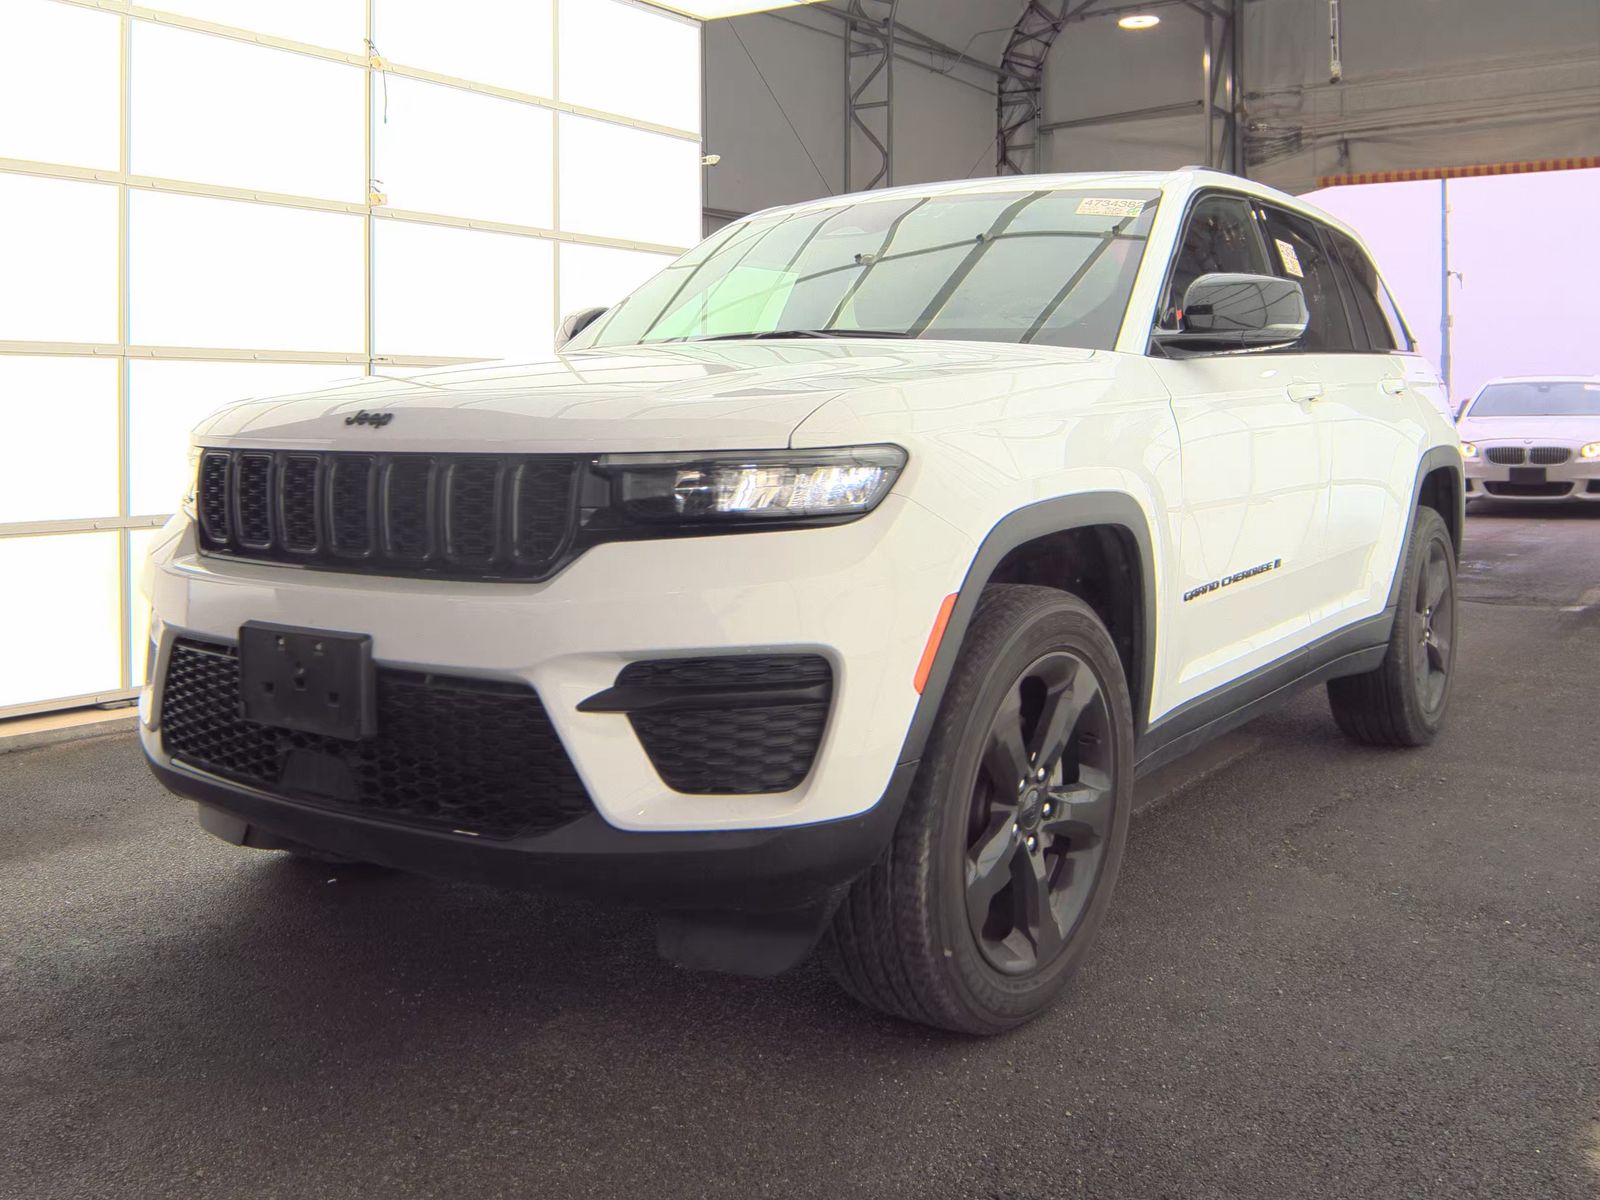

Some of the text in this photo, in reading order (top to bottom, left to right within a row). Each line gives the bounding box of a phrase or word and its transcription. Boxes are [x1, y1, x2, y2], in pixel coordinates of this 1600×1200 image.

[344, 409, 393, 429] Jeep
[1183, 561, 1274, 602] GRAND CHEROKEE
